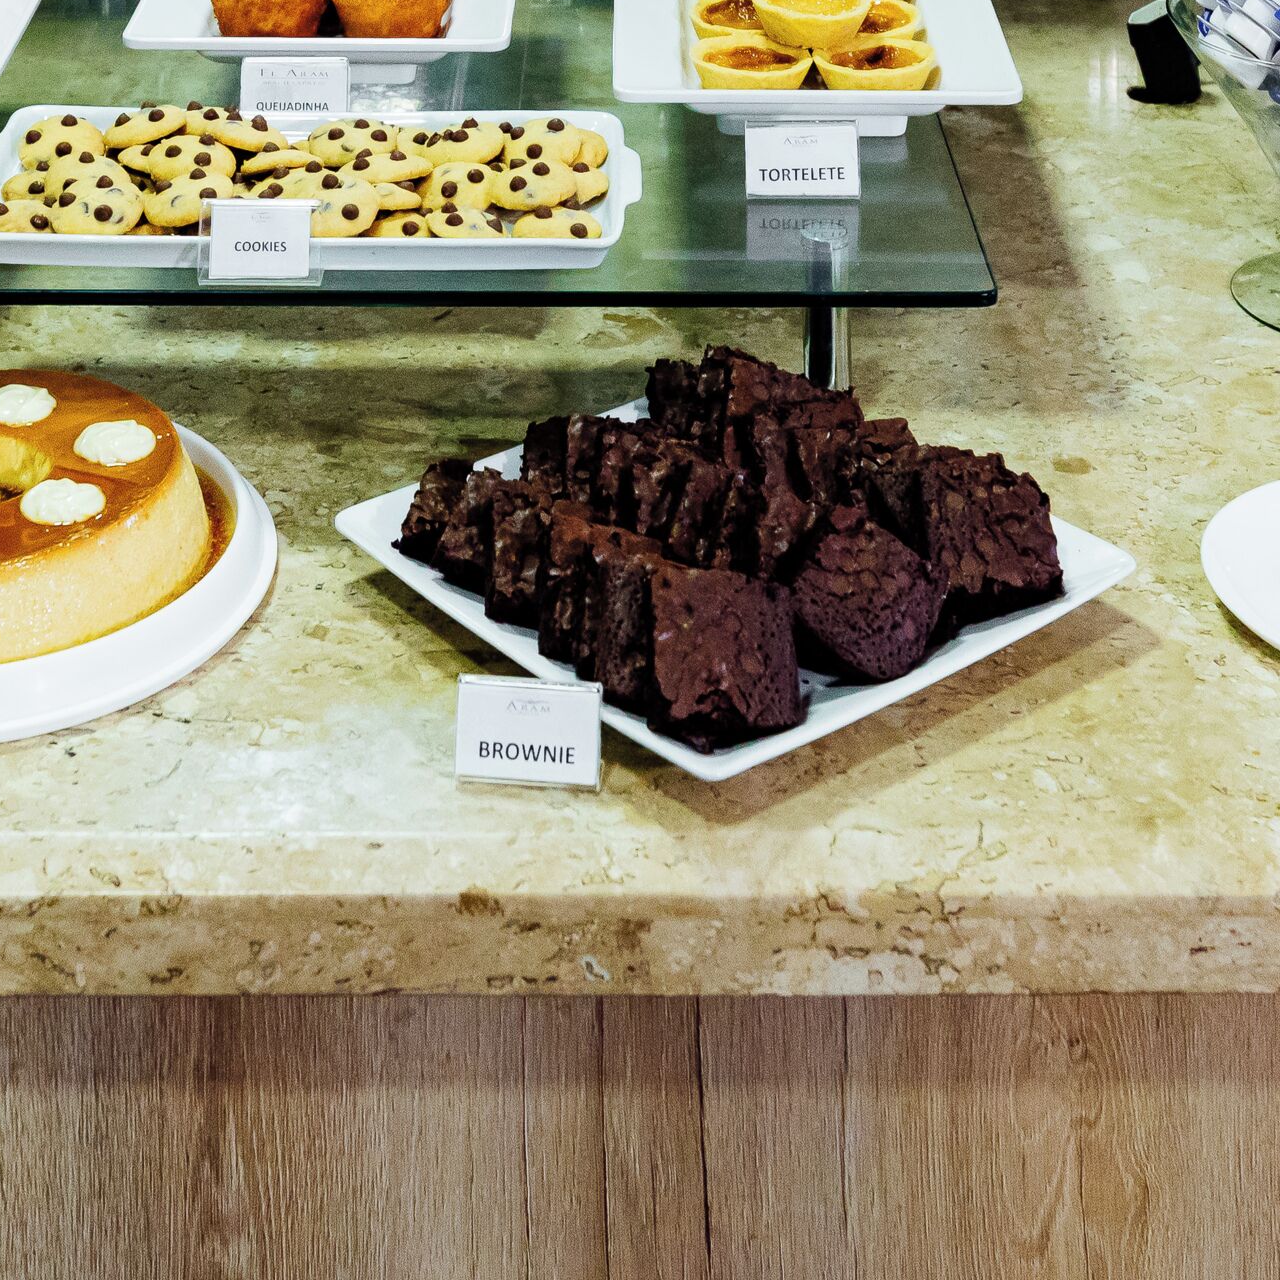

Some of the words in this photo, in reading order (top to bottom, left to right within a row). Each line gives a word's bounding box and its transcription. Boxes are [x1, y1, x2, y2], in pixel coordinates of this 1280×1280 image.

[256, 101, 329, 112] QUEIJADINHA
[759, 166, 846, 182] TORTELETE
[234, 241, 287, 253] COOKIES
[479, 740, 576, 765] BROWNIE
